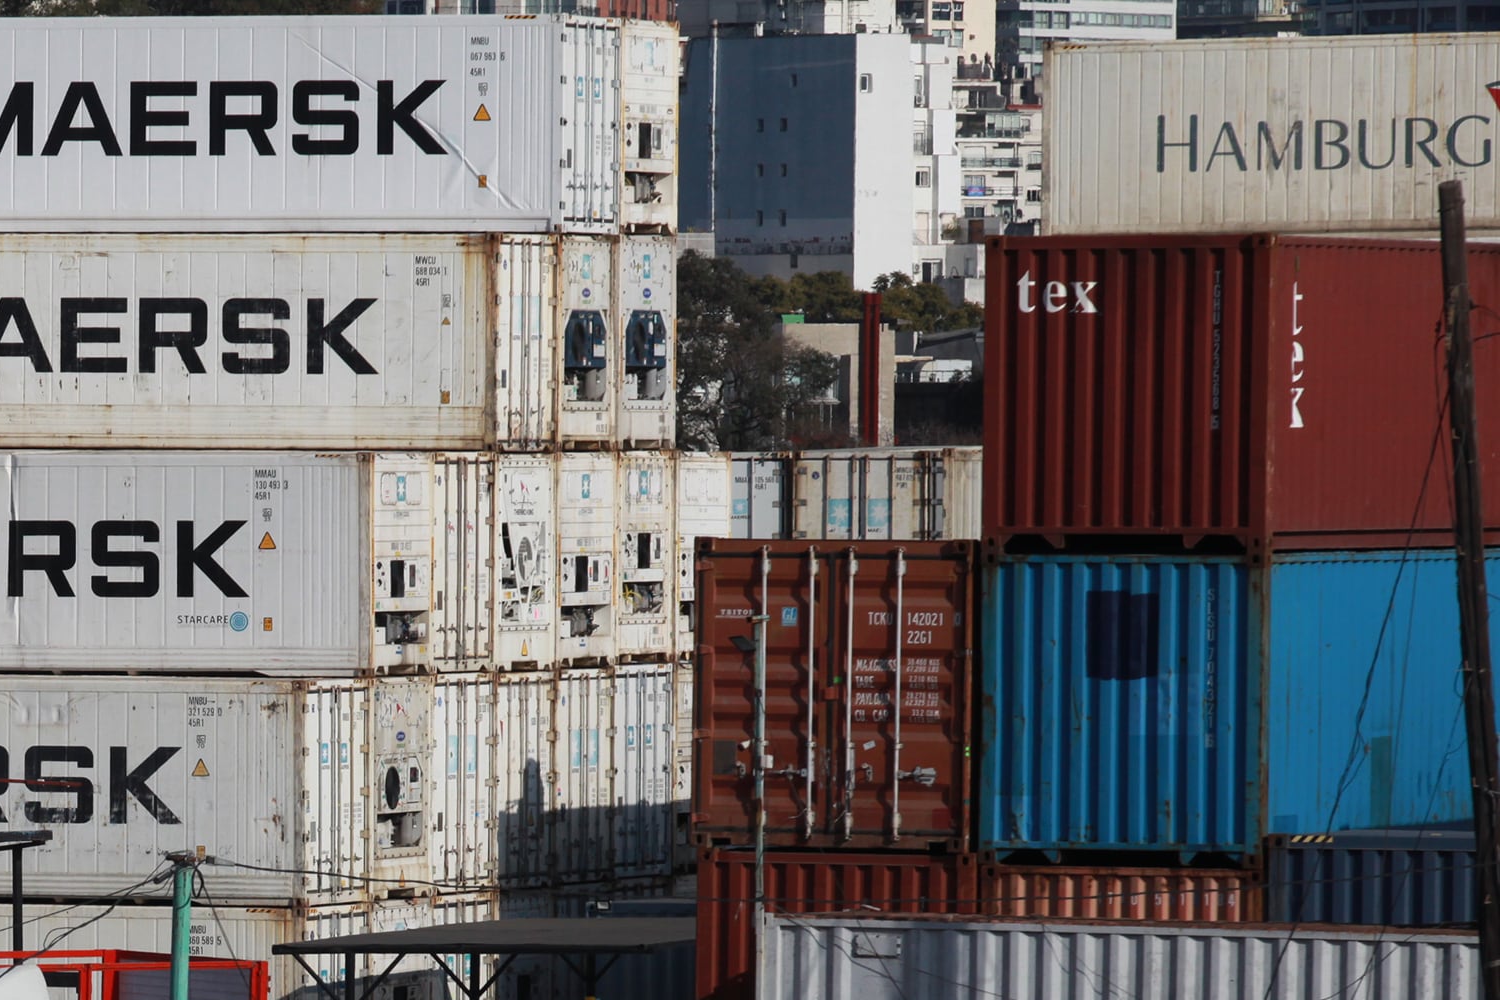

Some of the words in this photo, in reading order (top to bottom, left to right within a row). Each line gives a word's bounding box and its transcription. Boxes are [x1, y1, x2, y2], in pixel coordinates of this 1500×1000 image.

[470, 37, 490, 46] MNBU
[470, 68, 486, 77] 45R1
[1156, 115, 1491, 173] HAMBURG
[415, 256, 437, 265] MWCU
[415, 267, 428, 276] 688
[429, 267, 441, 276] 034
[415, 278, 430, 287] 45R1
[1017, 271, 1098, 314] tex
[255, 469, 277, 478] MMAU
[255, 480, 268, 490] 130
[269, 480, 281, 490] 493
[283, 480, 288, 489] 3
[255, 492, 271, 500] 45R1
[177, 615, 229, 625] STARCARE
[868, 612, 893, 626] TCKU
[907, 612, 943, 626] 142021
[907, 630, 932, 645] 22G1
[188, 696, 208, 705] MNBU
[188, 708, 200, 717] 321
[201, 708, 214, 717] 529
[188, 719, 204, 727] 45R1
[201, 936, 214, 945] 589
[216, 936, 222, 945] 5
